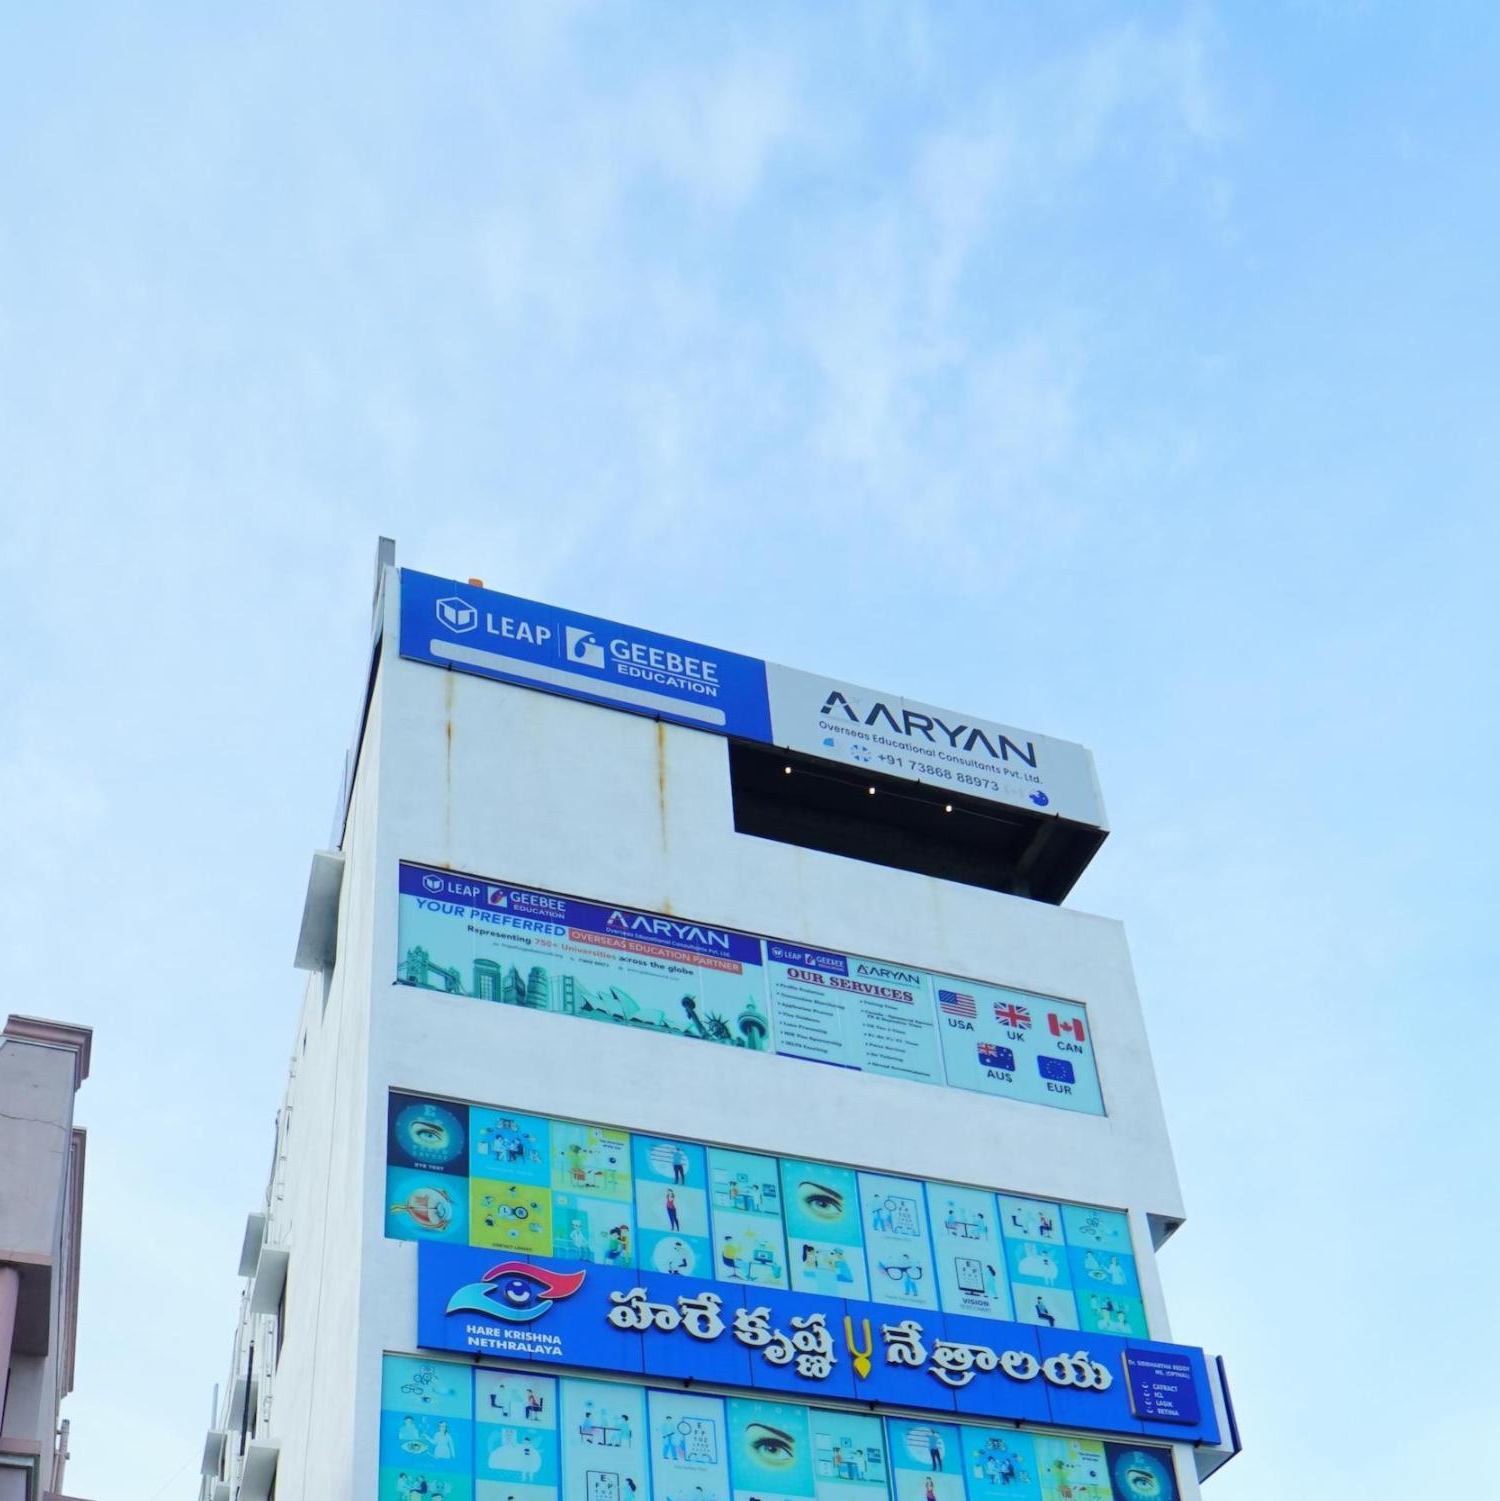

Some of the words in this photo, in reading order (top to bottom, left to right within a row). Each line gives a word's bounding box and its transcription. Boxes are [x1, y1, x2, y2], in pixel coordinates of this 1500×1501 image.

[487, 613, 551, 645] LEAP
[610, 639, 719, 683] GEEBEE
[617, 663, 717, 697] EDUCATION
[819, 719, 870, 741] Overseas
[873, 734, 936, 757] Educational
[938, 751, 1001, 774] Consultants
[820, 691, 1037, 768] AARYAN
[878, 753, 903, 767] +91
[909, 759, 952, 780] 73868
[957, 771, 1000, 792] 88973
[448, 882, 480, 897] LEAP
[510, 891, 566, 912] GEEBEE
[513, 904, 565, 919] EDUCATION
[417, 898, 465, 917] YOUR
[470, 908, 566, 937] PREFERRED
[606, 910, 729, 949] AARYAN
[468, 925, 531, 945] Representing
[619, 955, 648, 966] across
[650, 960, 665, 969] the
[668, 964, 694, 976] globe
[571, 931, 626, 948] OVERSEAS
[629, 941, 690, 961] EDUCATION
[693, 954, 740, 970] PARTNER
[787, 968, 825, 984] OUR
[830, 977, 914, 1003] SERVICES
[948, 1018, 975, 1032] USA
[1006, 1030, 1025, 1042] UK
[1057, 1041, 1083, 1054] CAN
[987, 1069, 1013, 1083] AUS
[1046, 1082, 1072, 1095] EUR
[466, 1324, 500, 1338] HARE
[504, 1329, 562, 1345] KRISHNA
[467, 1336, 563, 1356] NETHRALAYA
[733, 1305, 839, 1380] కృష్ణ
[882, 1320, 1115, 1391] నేత్రాలయ
